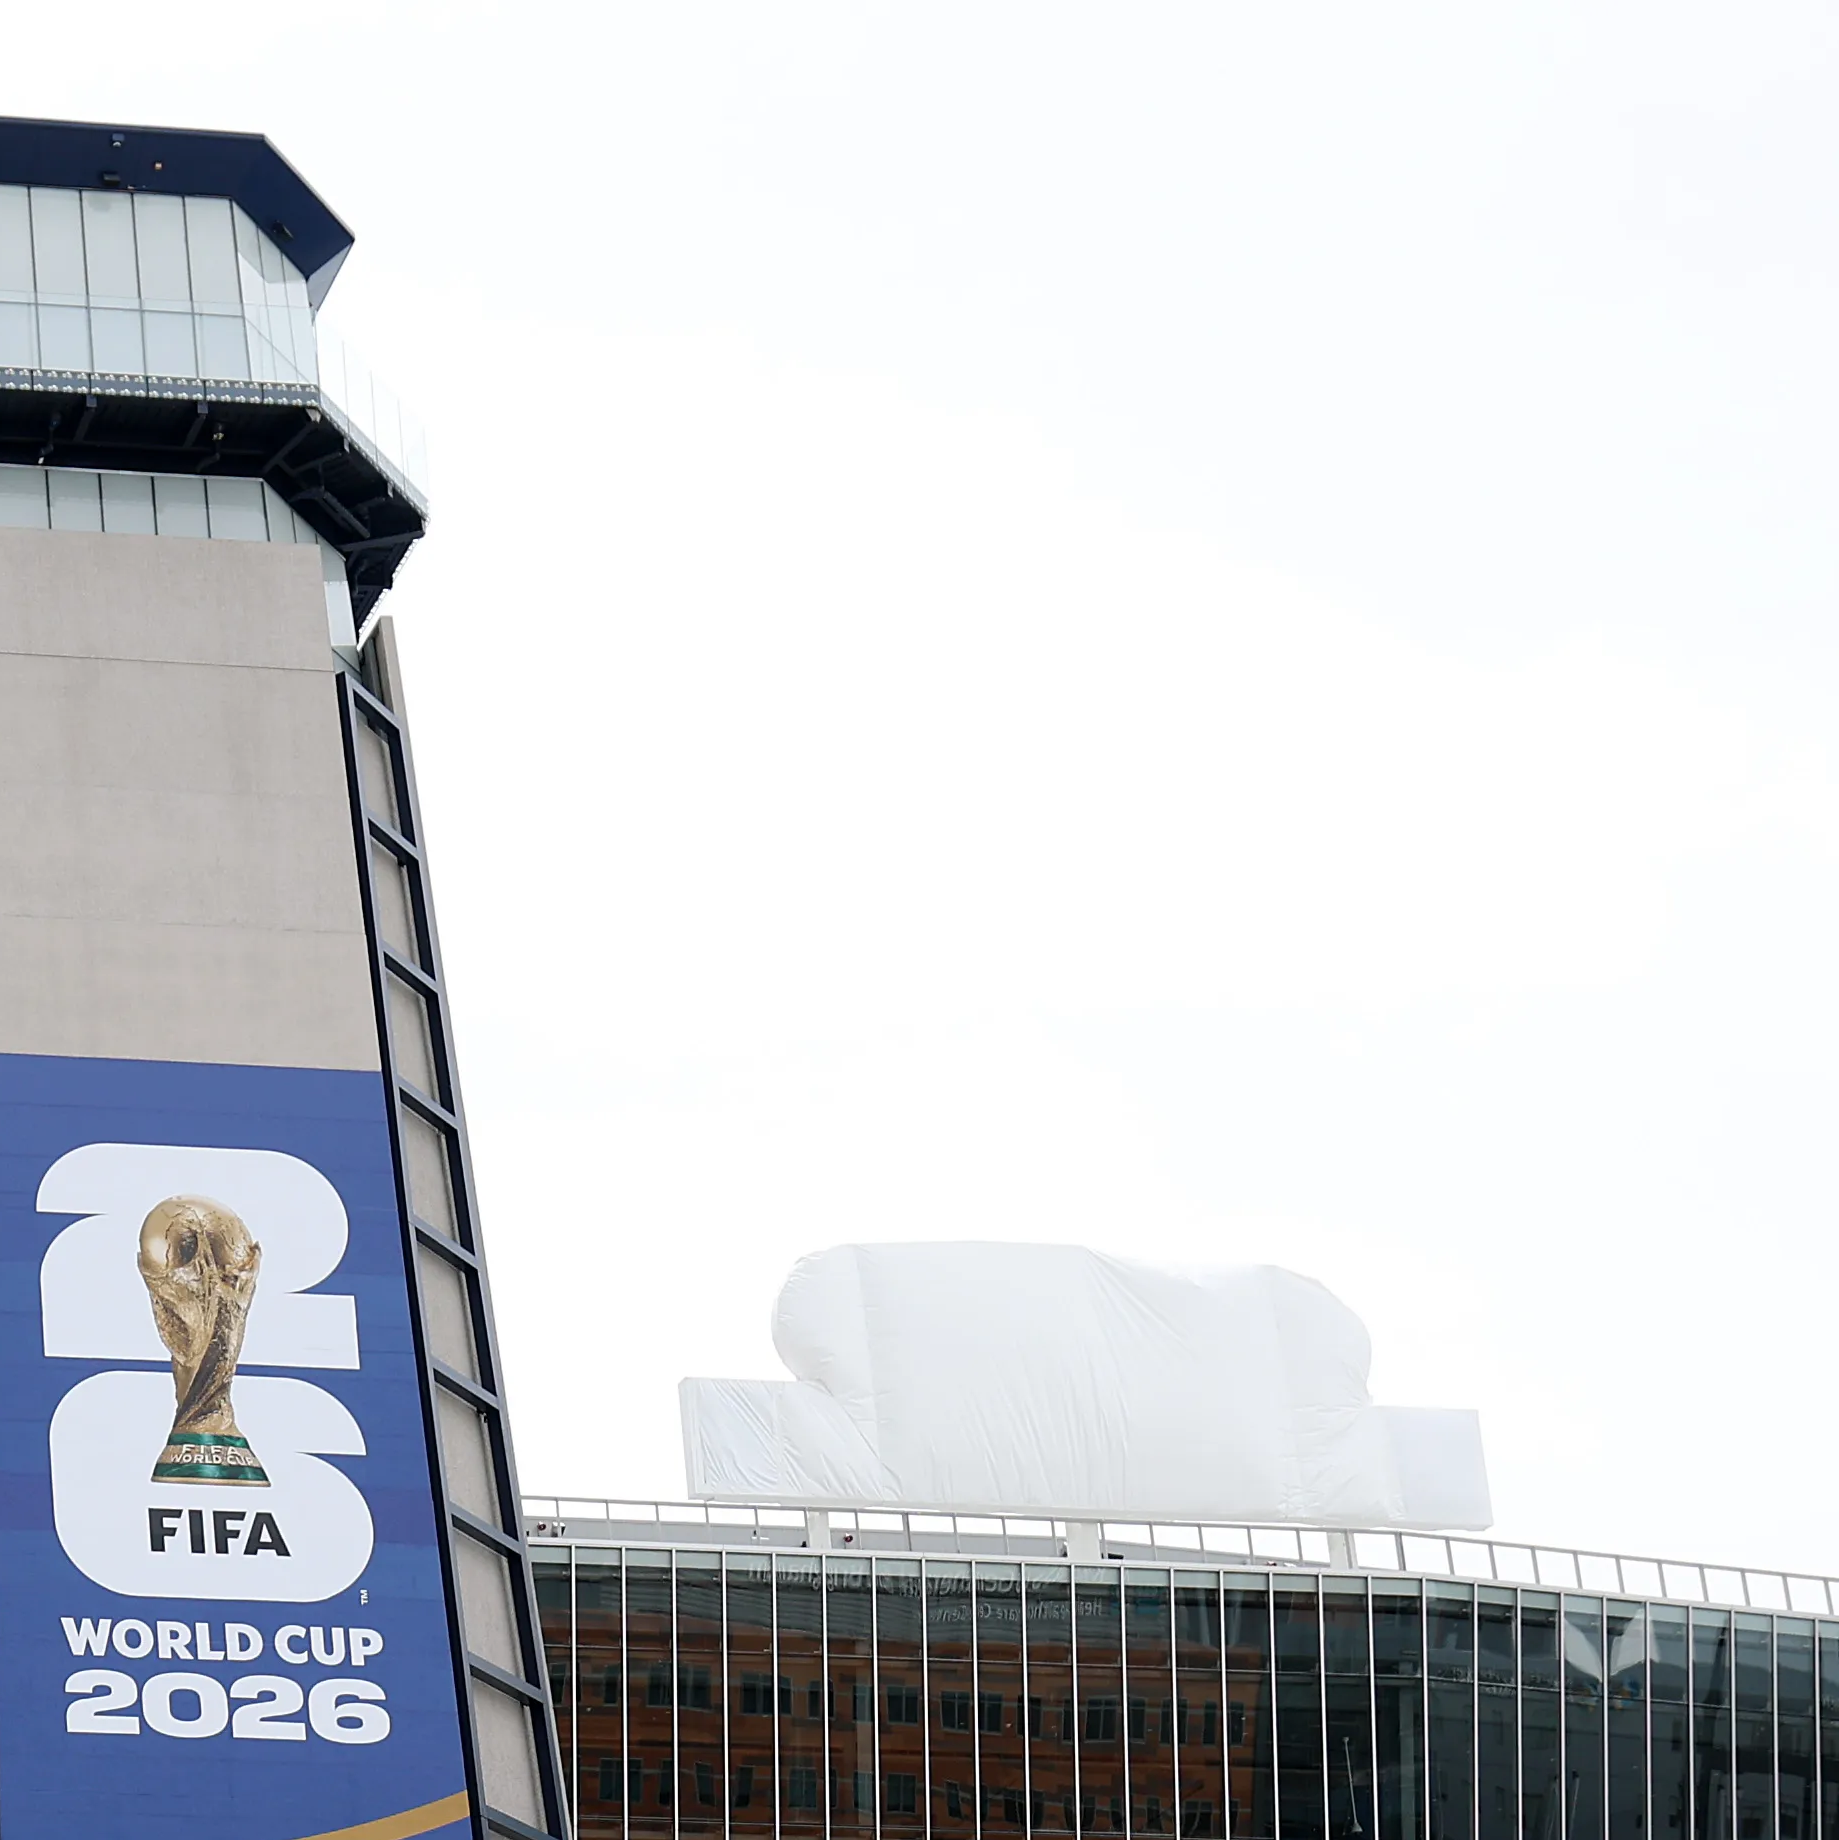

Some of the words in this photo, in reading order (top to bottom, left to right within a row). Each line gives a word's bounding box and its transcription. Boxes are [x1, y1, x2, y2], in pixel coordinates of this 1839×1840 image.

[170, 1453, 222, 1465] WORLD
[226, 1455, 254, 1467] CUP
[181, 1443, 240, 1455] FIFA
[147, 1507, 292, 1558] FIFA
[359, 1589, 369, 1606] TM
[60, 1616, 264, 1662] WORLD
[274, 1625, 384, 1667] CUP
[64, 1668, 392, 1745] 2026
